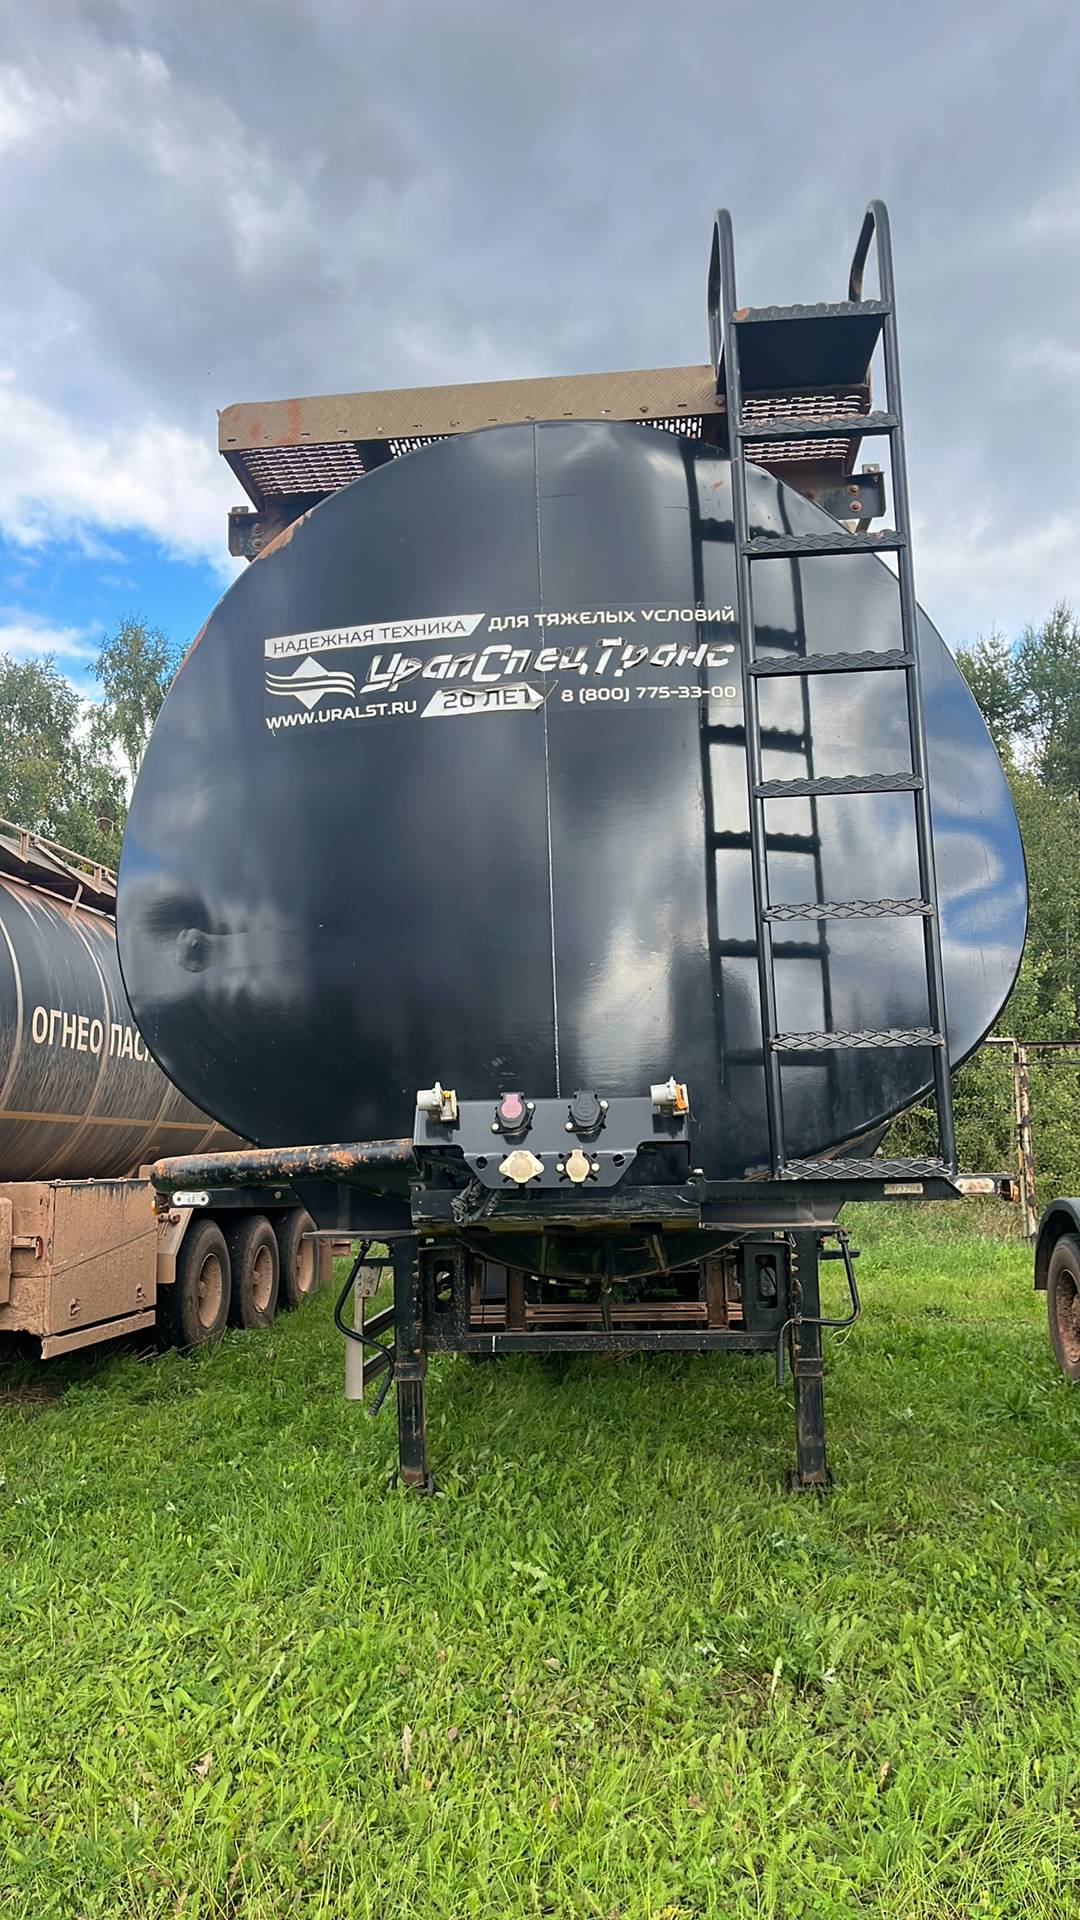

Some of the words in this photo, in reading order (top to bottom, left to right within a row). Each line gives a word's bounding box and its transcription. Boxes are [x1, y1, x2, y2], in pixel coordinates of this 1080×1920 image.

[273, 629, 375, 655] НАДЕЖНАЯ
[380, 620, 467, 641] ТЕХНИКА
[487, 614, 530, 632] ДЛЯ
[534, 610, 637, 627] ТЯЖЕЛЫХ
[641, 605, 736, 623] УСЛОВИЙ
[442, 692, 476, 710] 20
[484, 688, 531, 707] ЛЕТ
[560, 688, 574, 702] 8
[579, 687, 631, 704] (800)
[635, 685, 737, 700] 775-33-00
[265, 700, 418, 730] WWW.URALST.RU
